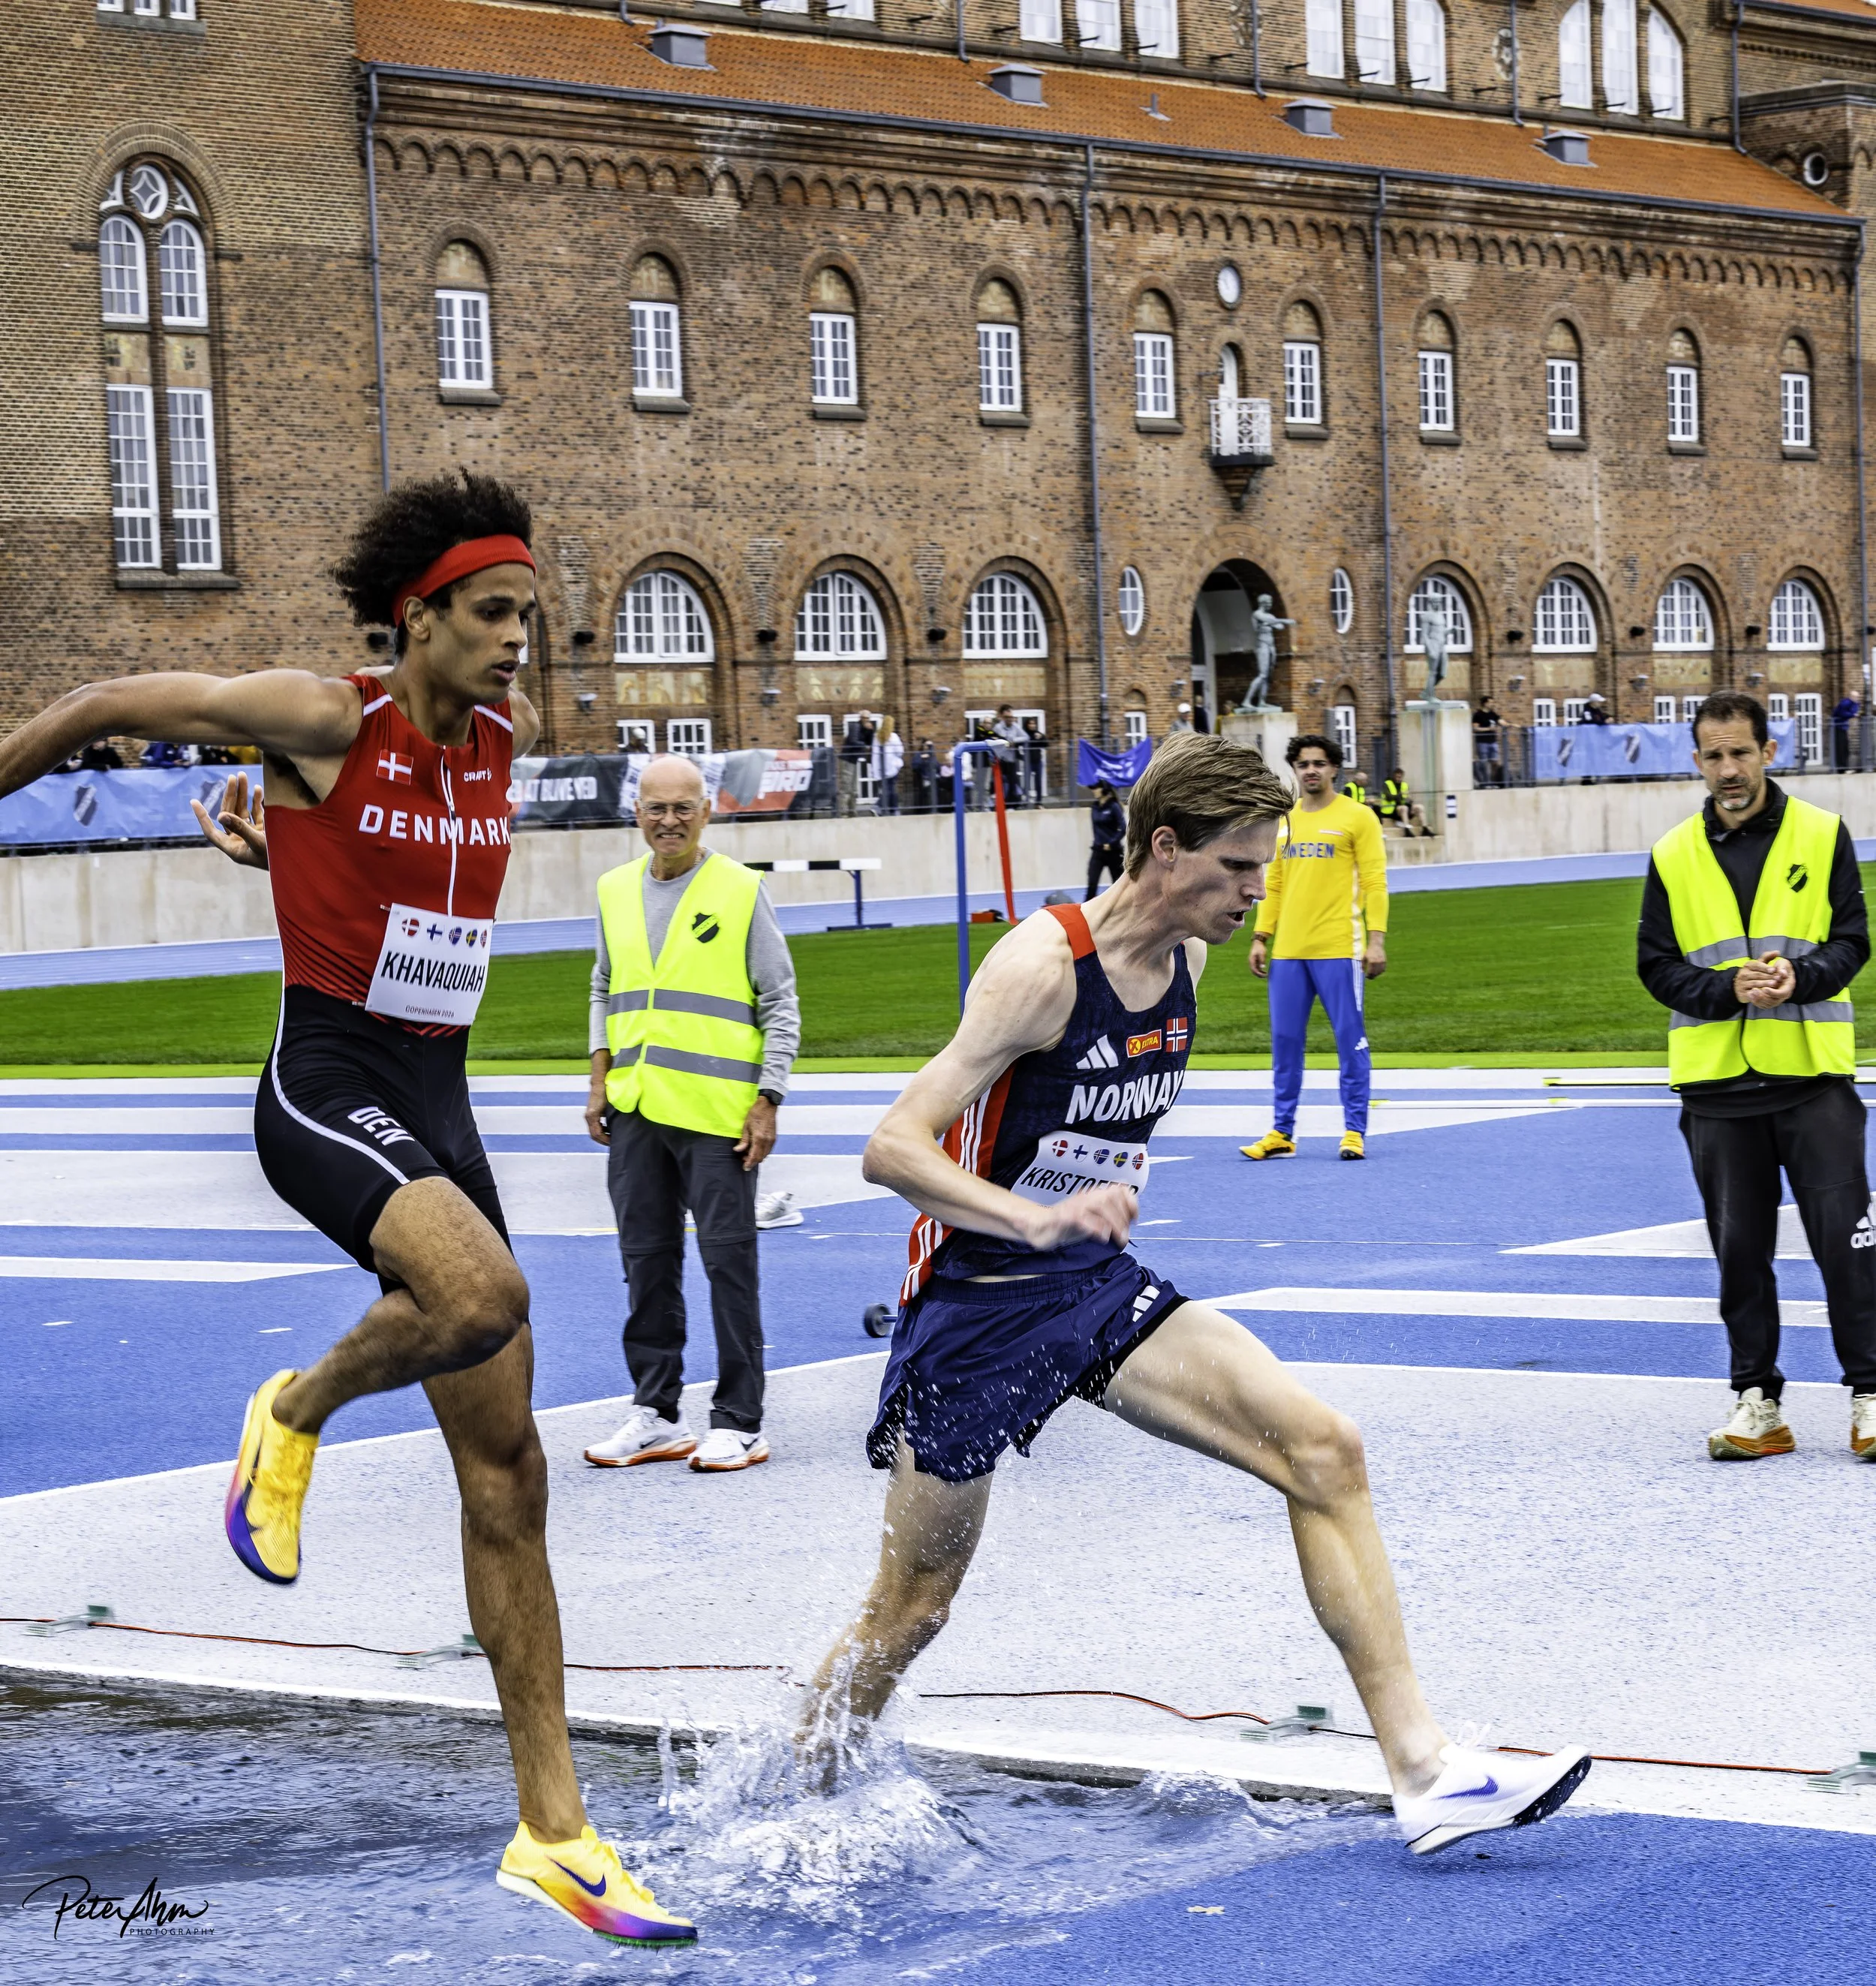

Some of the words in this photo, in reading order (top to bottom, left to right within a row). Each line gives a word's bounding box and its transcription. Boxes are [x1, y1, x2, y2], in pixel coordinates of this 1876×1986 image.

[464, 770, 486, 781] CRAFT
[359, 803, 511, 846] DENMARK
[380, 949, 486, 993] KHAVAQUIAH
[405, 1005, 441, 1016] COPENHAGEN
[1065, 1070, 1186, 1124] NORWAY
[347, 1106, 416, 1146] DEN
